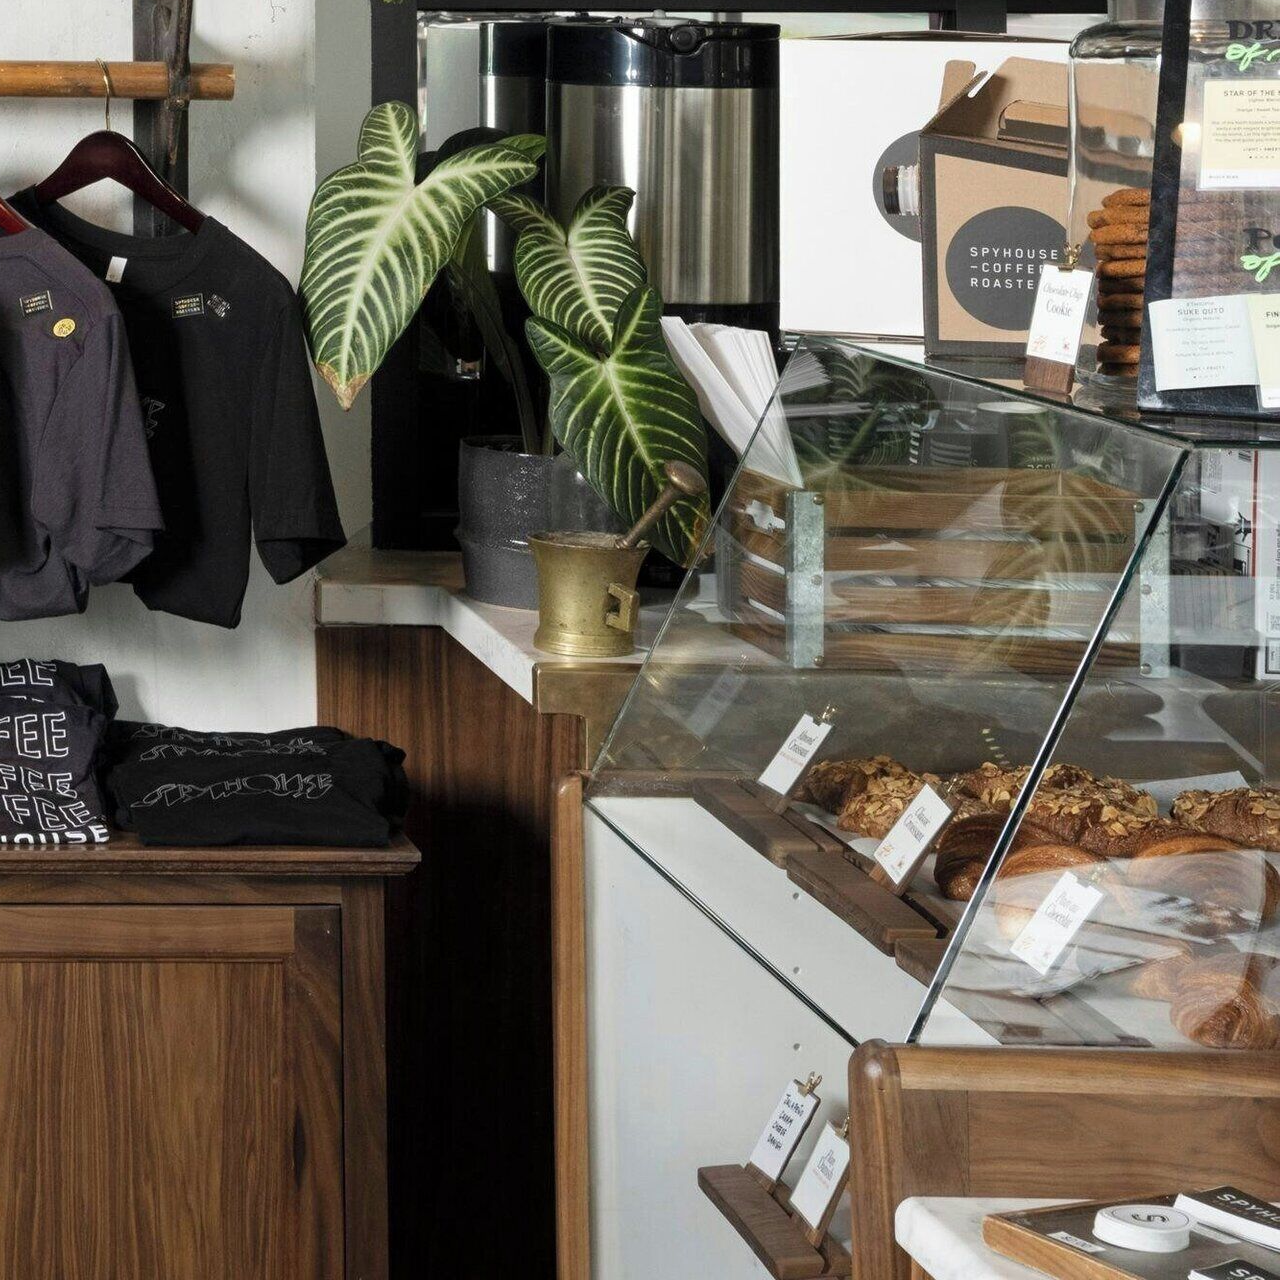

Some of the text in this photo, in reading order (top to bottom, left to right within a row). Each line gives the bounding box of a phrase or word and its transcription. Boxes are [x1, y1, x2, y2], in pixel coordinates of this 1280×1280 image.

[1225, 20, 1280, 40] DR
[970, 247, 1059, 260] SPYHOUSE
[970, 277, 1035, 290] ROASTE
